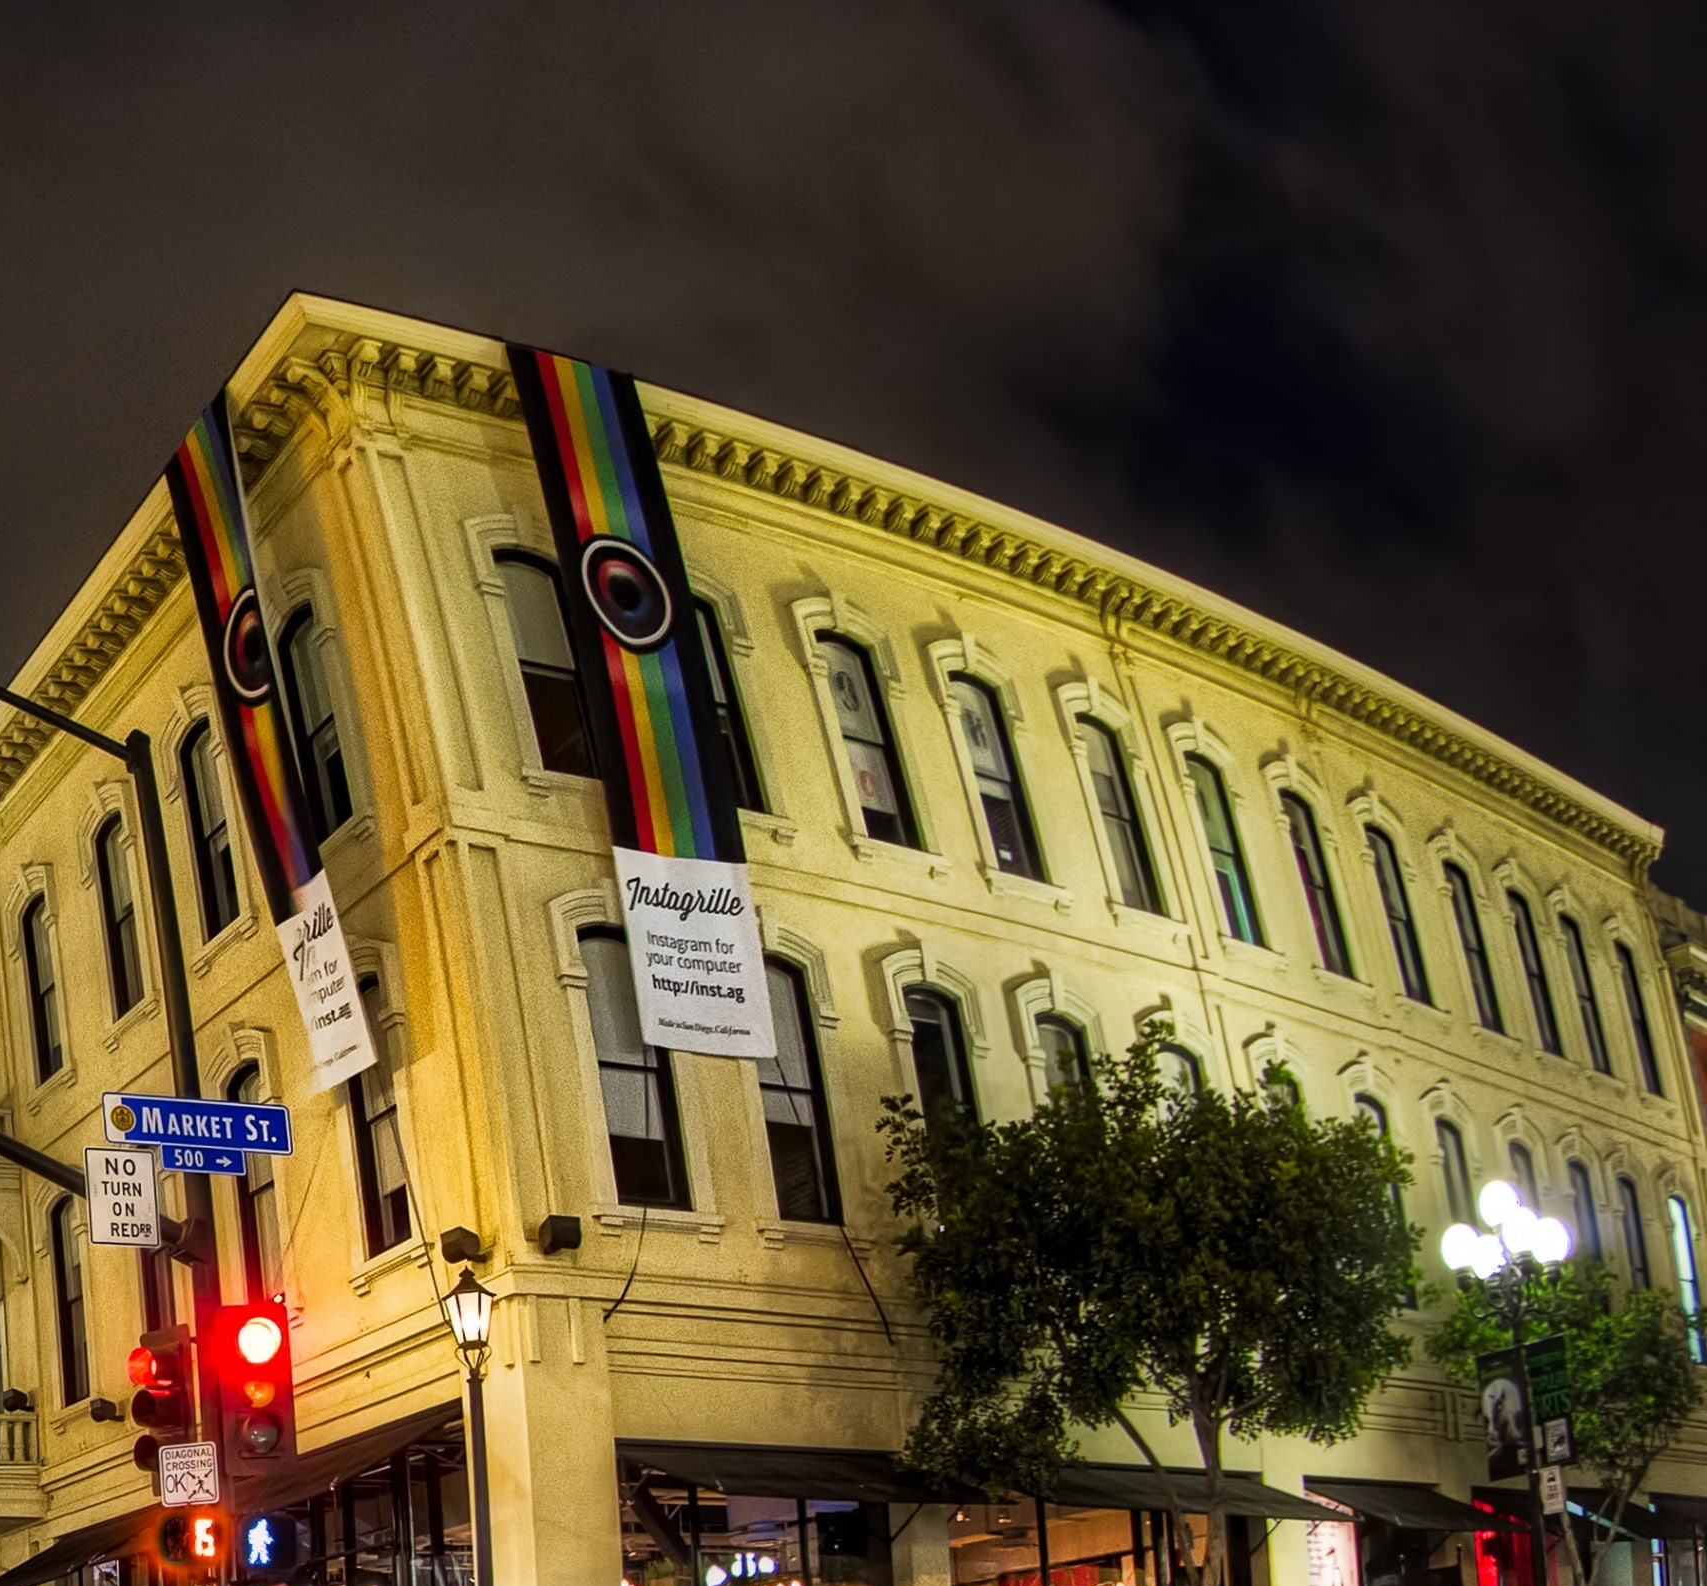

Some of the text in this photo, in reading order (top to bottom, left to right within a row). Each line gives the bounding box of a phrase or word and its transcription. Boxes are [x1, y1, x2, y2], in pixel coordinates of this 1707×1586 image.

[626, 876, 744, 922] Instagrille
[646, 930, 735, 955] Instagram for
[646, 950, 742, 975] your computer
[651, 974, 746, 1004] http://inst.ag
[141, 1106, 278, 1143] MARKET ST.
[105, 1157, 136, 1176] NO
[174, 1149, 204, 1167] 500
[101, 1181, 142, 1197] TURN
[113, 1202, 135, 1217] ON
[110, 1222, 140, 1238] RED
[165, 1447, 212, 1460] DIAGONAL
[166, 1459, 213, 1471] CROSSING
[166, 1473, 187, 1493] OK
